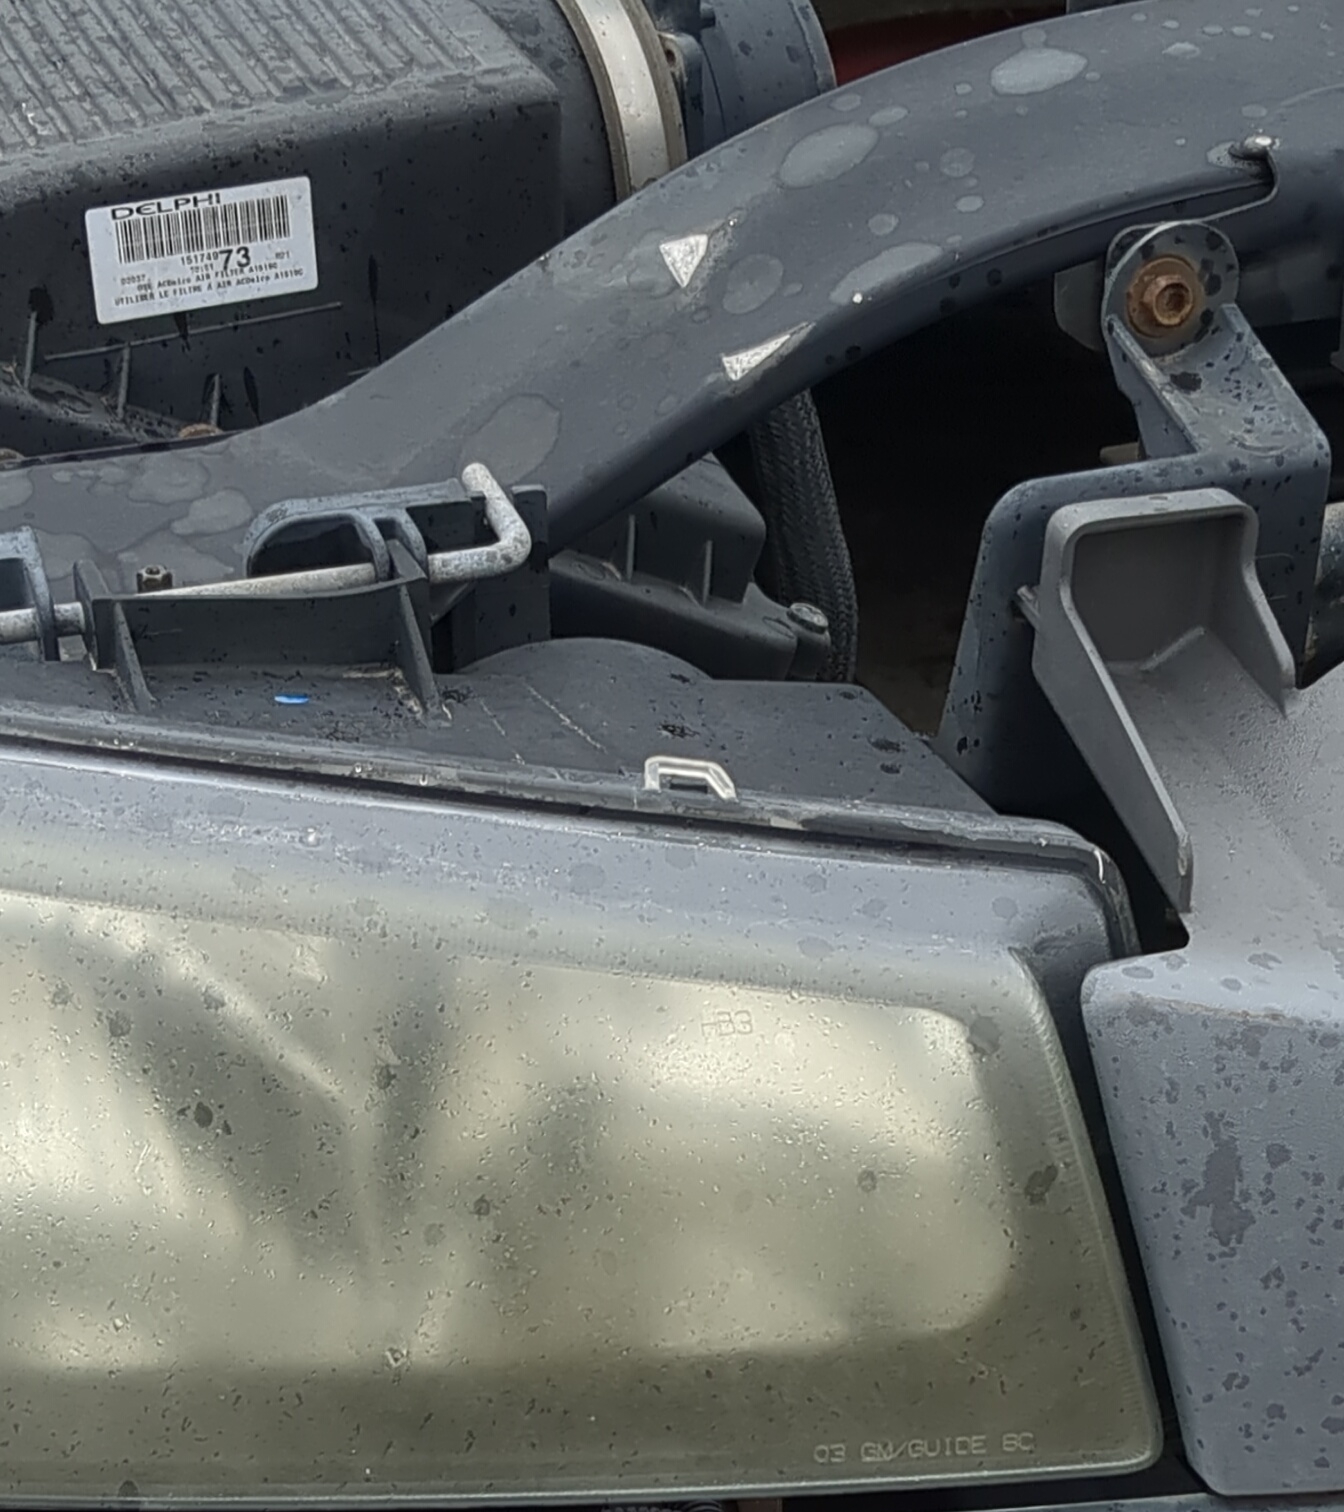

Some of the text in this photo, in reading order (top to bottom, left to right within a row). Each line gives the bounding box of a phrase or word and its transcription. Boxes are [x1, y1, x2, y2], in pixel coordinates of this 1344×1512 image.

[110, 192, 222, 221] DELPHI
[195, 272, 210, 282] AIR
[214, 267, 244, 279] FILTER
[216, 279, 231, 289] AIR
[860, 1435, 987, 1464] GM/GUIDE
